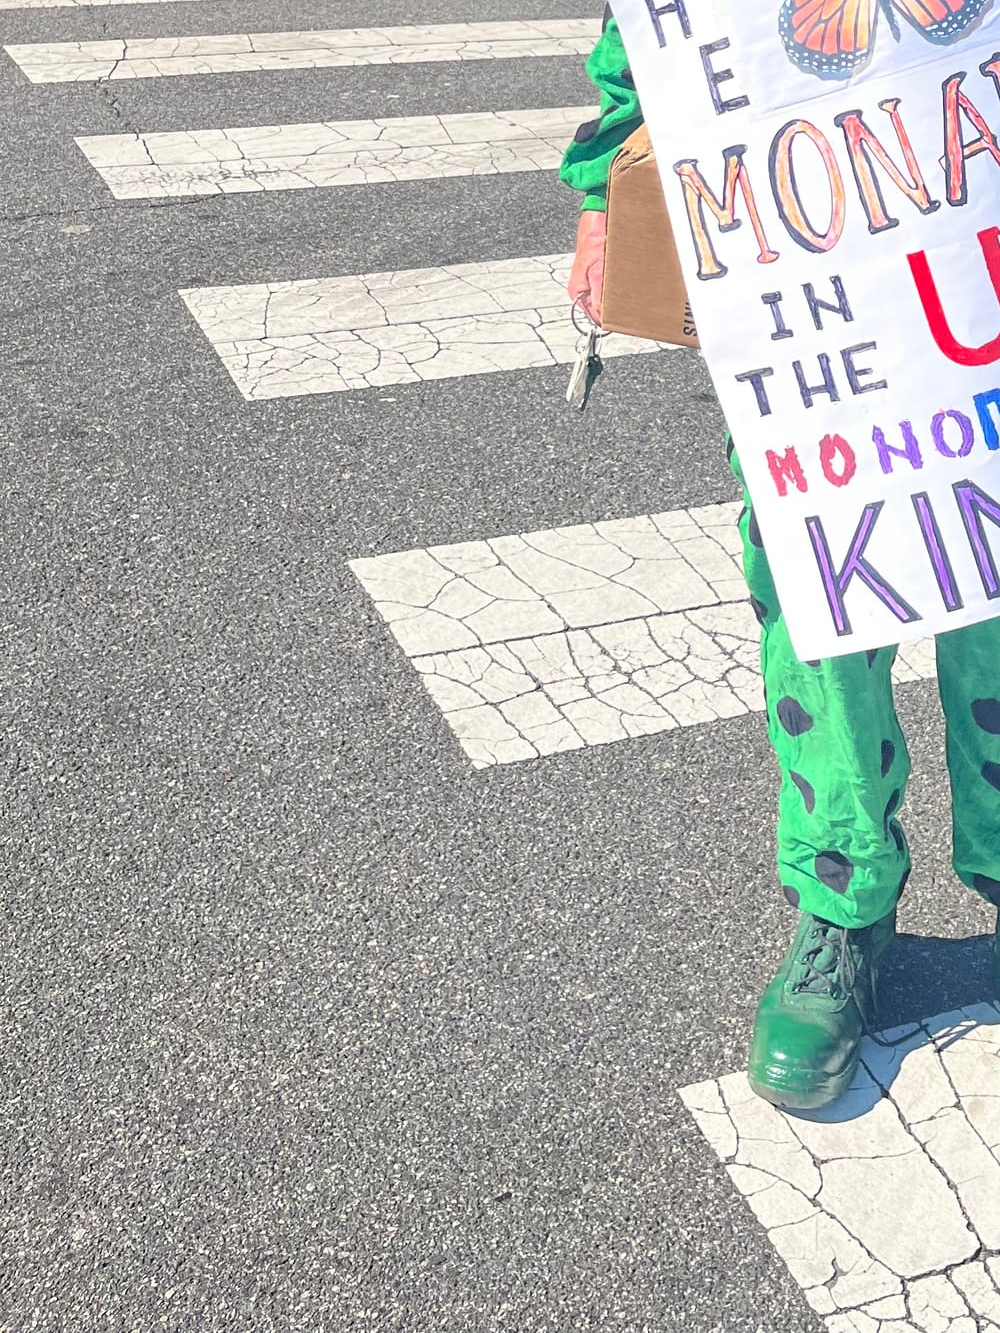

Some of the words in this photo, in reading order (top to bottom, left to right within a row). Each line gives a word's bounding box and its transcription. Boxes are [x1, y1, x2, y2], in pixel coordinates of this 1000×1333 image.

[761, 275, 854, 341] IN
[736, 341, 888, 416] THE
[871, 408, 975, 474] NO
